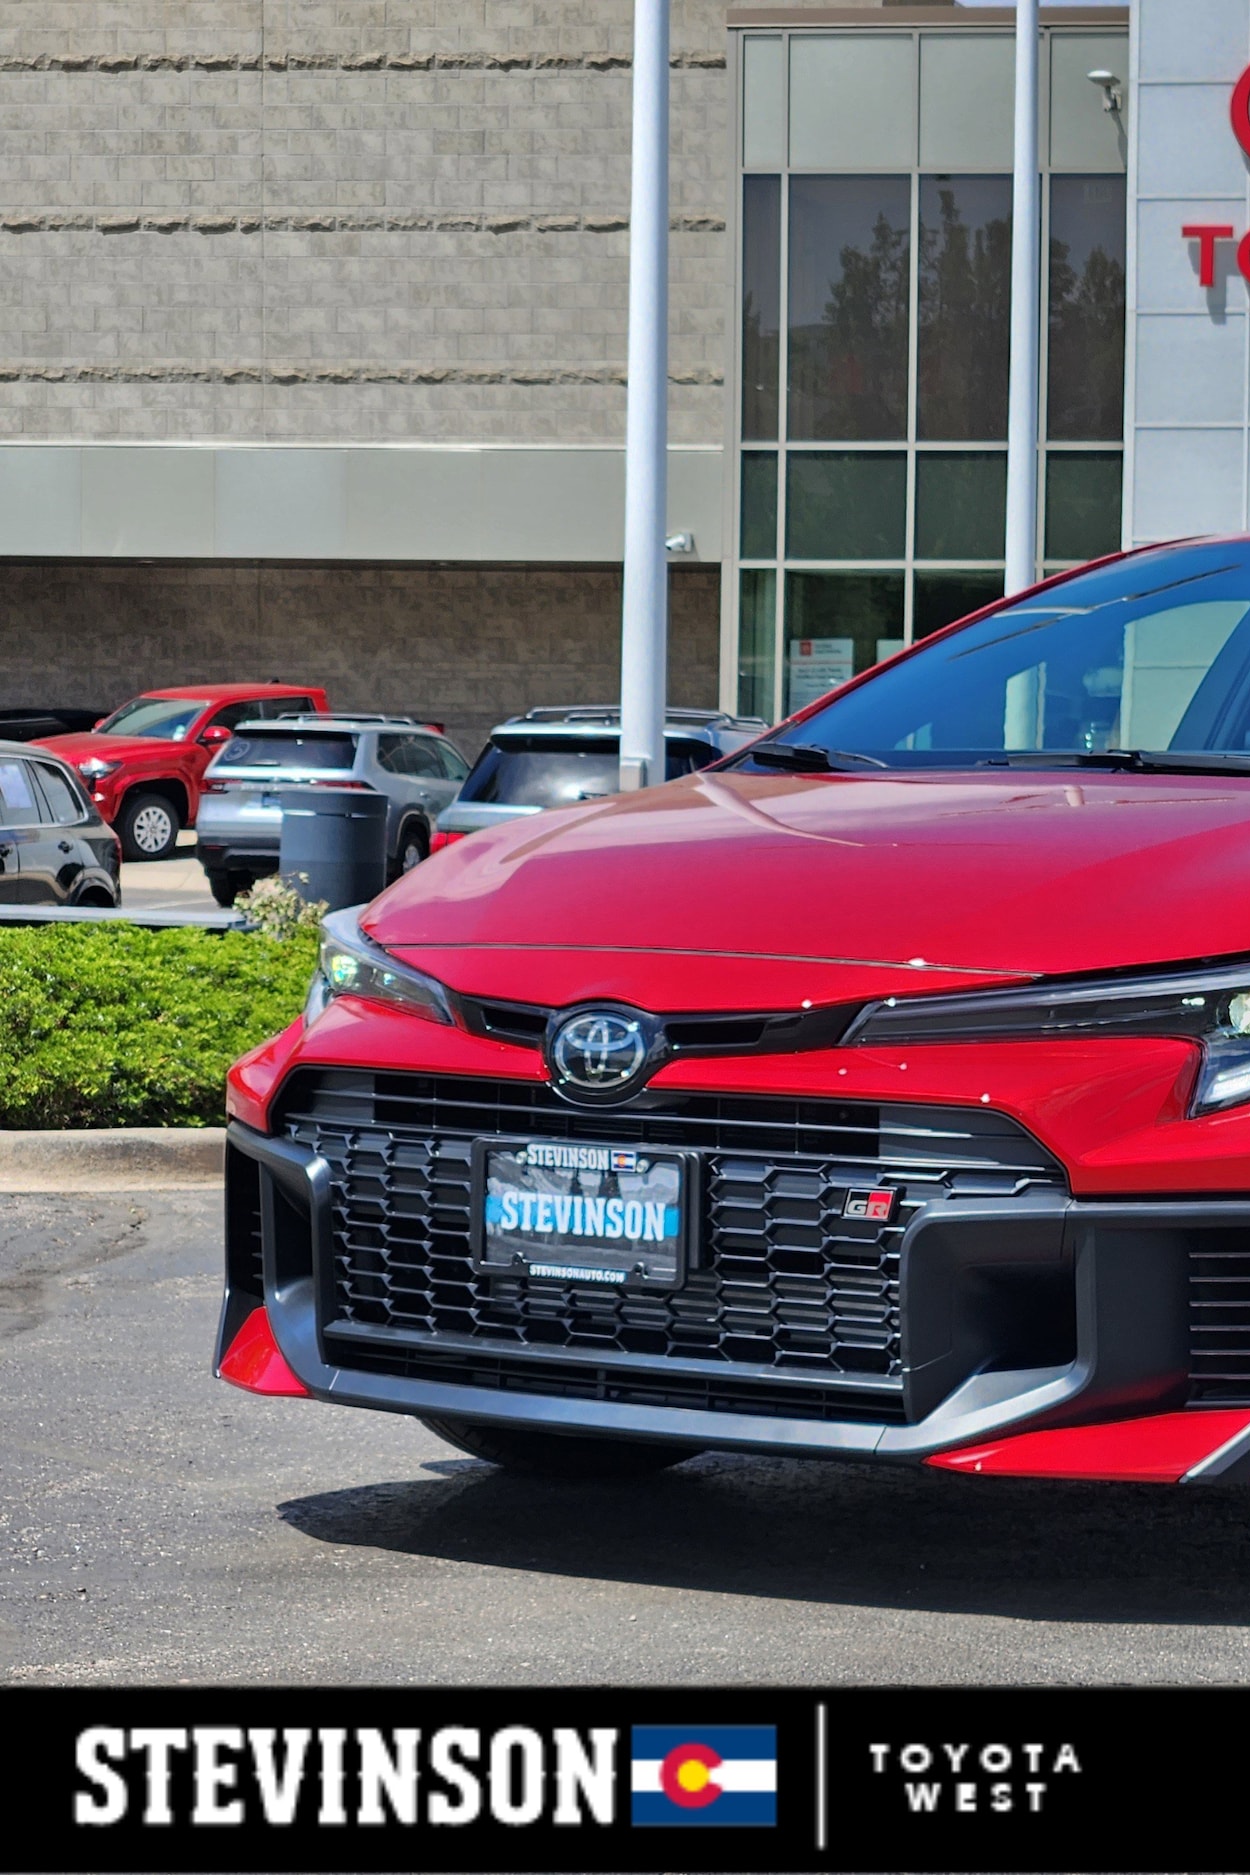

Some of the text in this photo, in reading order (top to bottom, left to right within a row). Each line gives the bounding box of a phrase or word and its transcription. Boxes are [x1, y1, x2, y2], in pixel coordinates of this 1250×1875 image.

[526, 1143, 610, 1171] STEVINSON
[501, 1191, 667, 1242] STEVINSON
[529, 1263, 625, 1284] STEVINSONAUTO.COM
